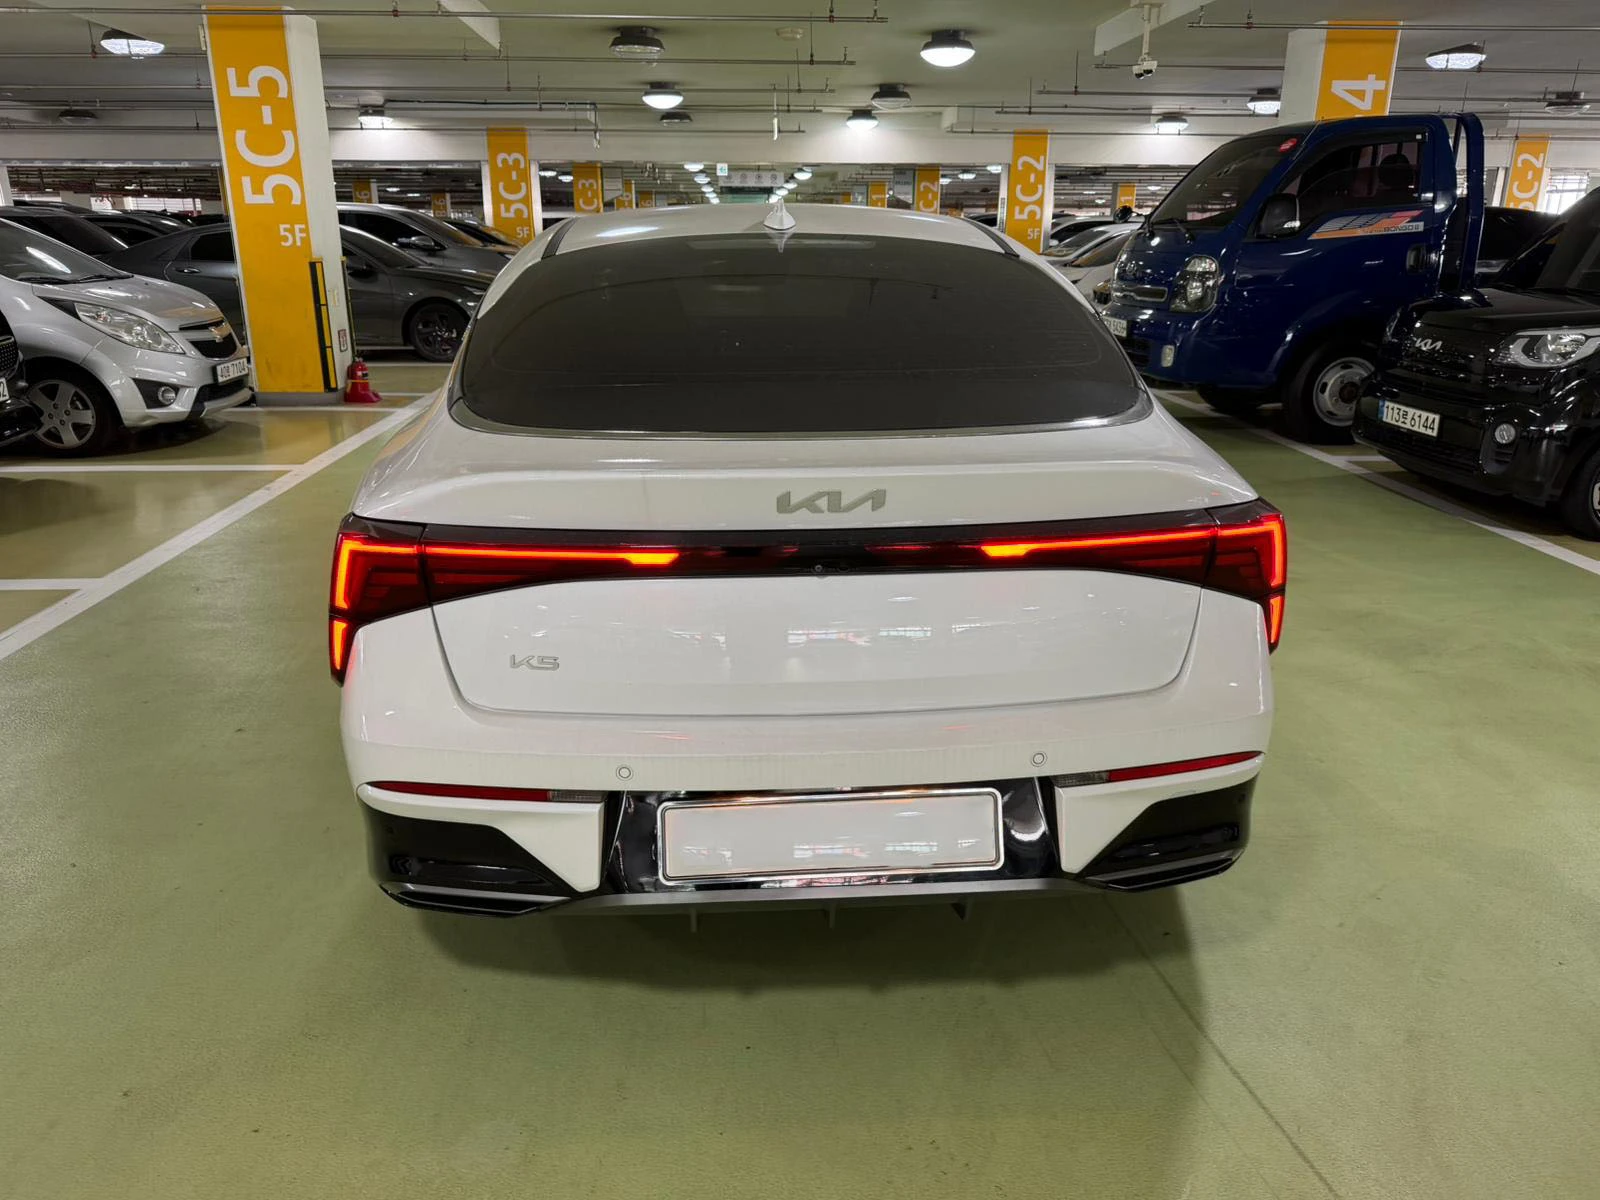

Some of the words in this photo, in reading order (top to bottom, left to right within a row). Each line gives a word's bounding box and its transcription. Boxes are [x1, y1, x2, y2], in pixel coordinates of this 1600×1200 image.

[226, 65, 302, 205] 5C-5
[496, 152, 528, 218] 5C-3
[578, 179, 598, 210] C-3
[920, 181, 938, 212] C-2
[1014, 155, 1045, 220] 5C-2
[279, 224, 307, 247] 5F
[515, 226, 530, 238] 5F
[1027, 228, 1041, 240] 5F
[776, 488, 887, 514] KIA
[510, 654, 560, 671] K5
